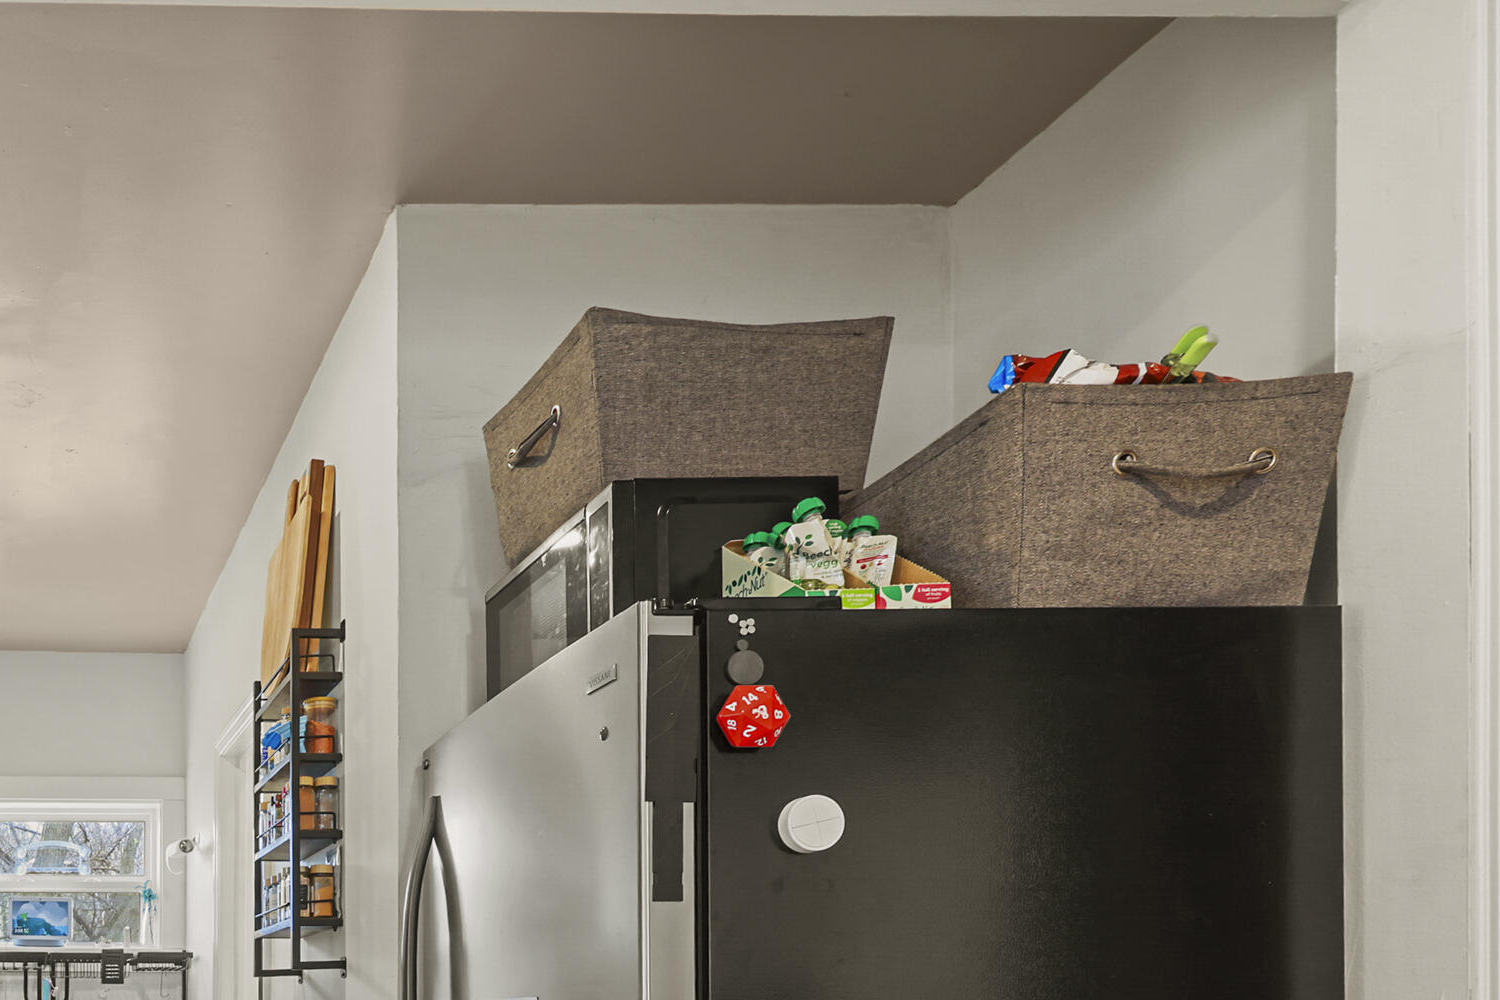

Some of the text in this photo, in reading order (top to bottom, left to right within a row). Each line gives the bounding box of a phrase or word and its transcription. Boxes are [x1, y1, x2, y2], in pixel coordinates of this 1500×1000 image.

[742, 692, 759, 705] 14
[725, 701, 738, 711] 4
[774, 709, 784, 719] 8
[727, 719, 737, 731] 18
[743, 724, 757, 738] 2
